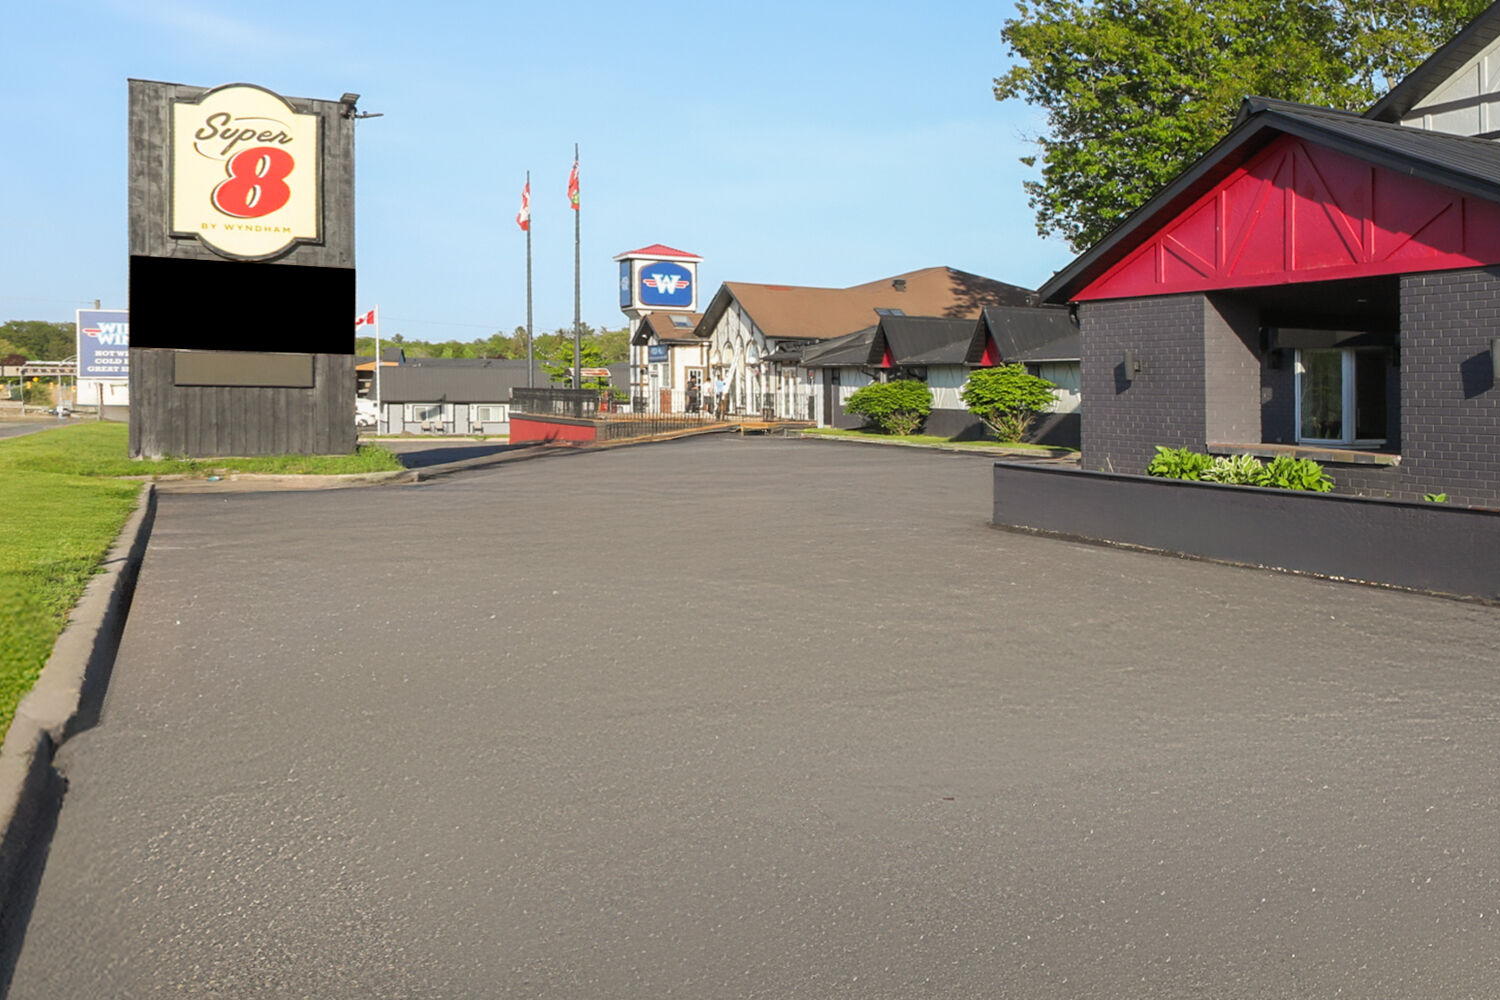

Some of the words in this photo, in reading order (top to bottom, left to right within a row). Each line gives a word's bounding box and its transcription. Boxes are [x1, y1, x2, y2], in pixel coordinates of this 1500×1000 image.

[194, 112, 293, 156] Super
[210, 146, 295, 219] 8
[201, 222, 217, 230] BY
[223, 223, 292, 234] WYNDHAM
[651, 273, 681, 295] W
